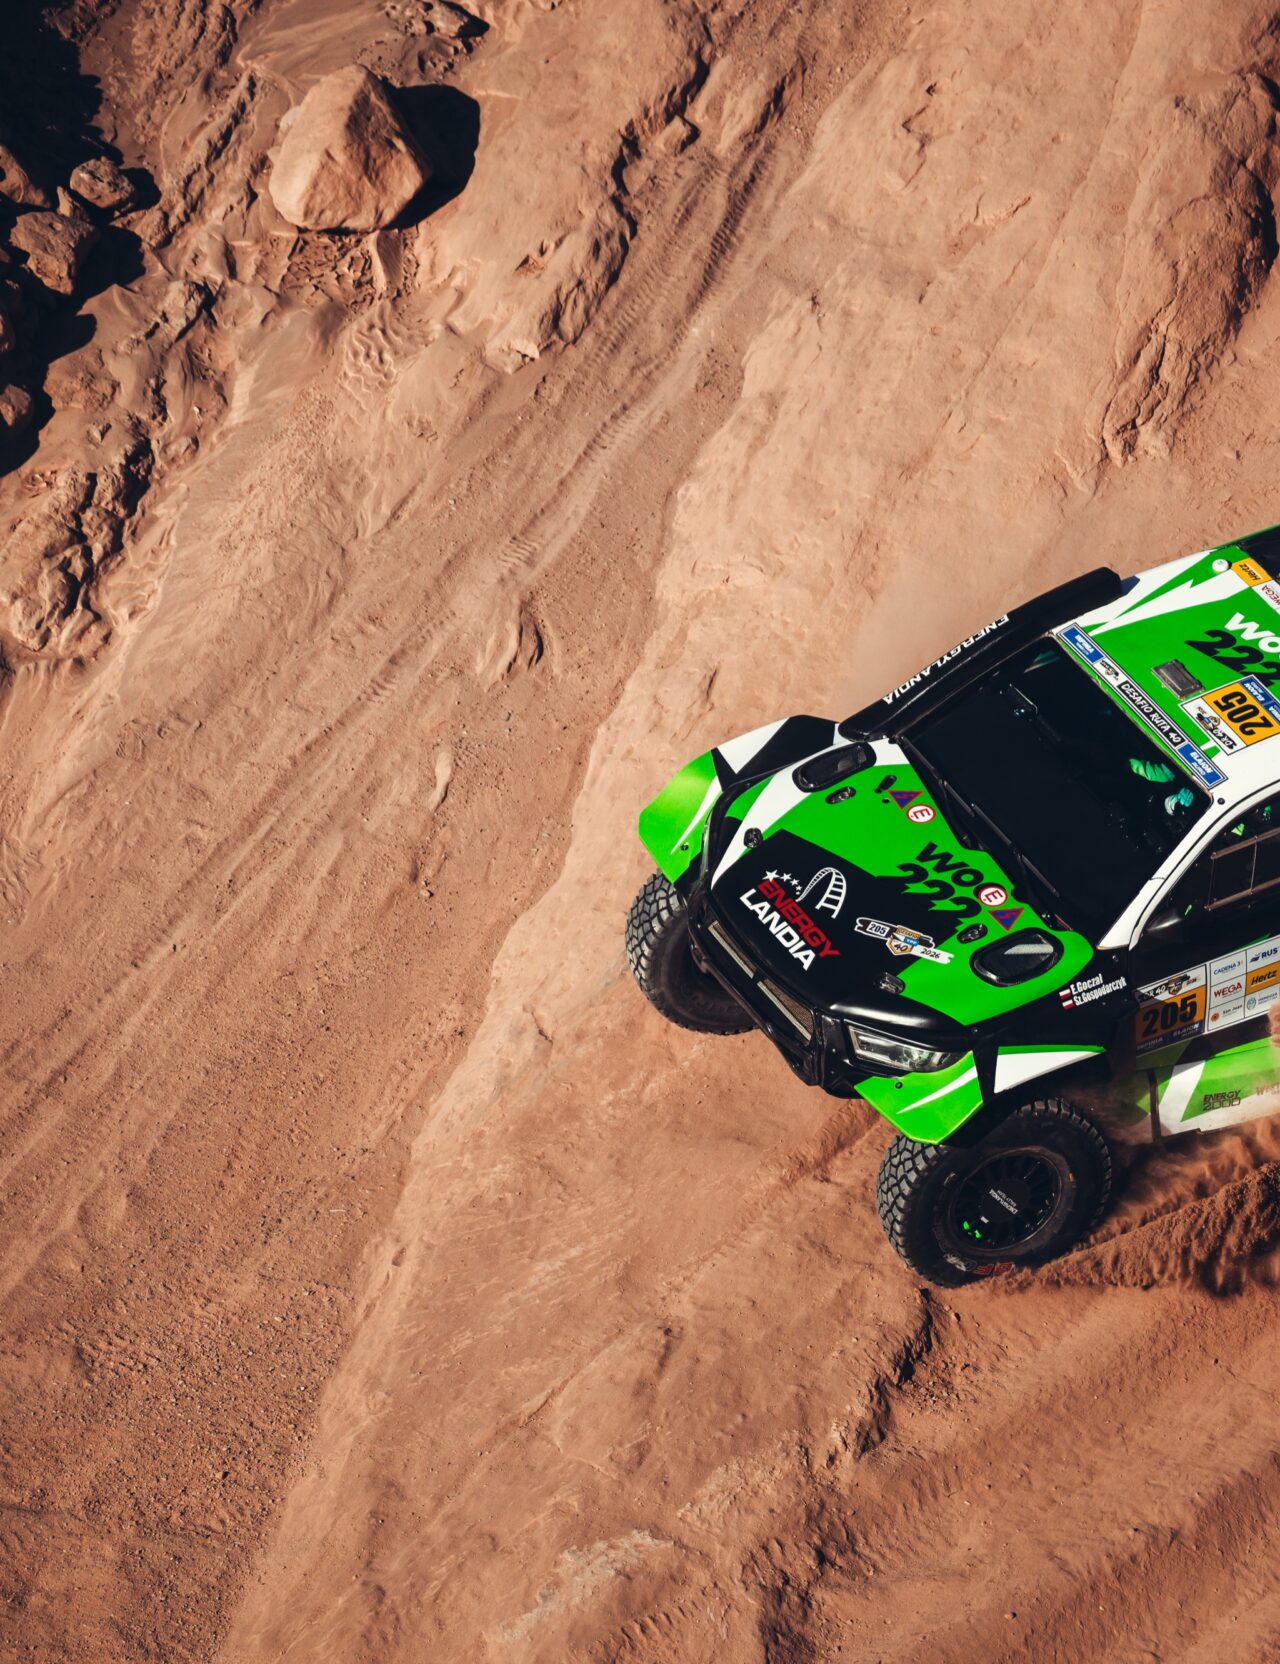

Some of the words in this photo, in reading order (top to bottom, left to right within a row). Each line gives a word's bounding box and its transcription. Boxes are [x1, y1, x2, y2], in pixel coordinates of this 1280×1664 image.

[883, 614, 1009, 704] ENERGYLANDIA
[1121, 683, 1153, 713] DESAFIO
[1149, 712, 1171, 732] RUTA
[1168, 731, 1182, 743] 40
[1213, 691, 1274, 736] 205
[1189, 751, 1214, 773] ELAION
[757, 879, 841, 958] ENERGY
[740, 888, 816, 971] LANDIA
[870, 923, 887, 935] 205
[894, 943, 909, 952] 40
[920, 948, 941, 959] 2026
[1261, 947, 1278, 959] RUS
[1213, 963, 1237, 975] CADENA
[1251, 969, 1277, 986] Hertz
[1154, 985, 1166, 995] 40
[1213, 982, 1242, 998] WEGA
[1142, 993, 1197, 1038] 205
[1203, 1098, 1241, 1111] 2000
[1204, 1090, 1241, 1103] ENERGY
